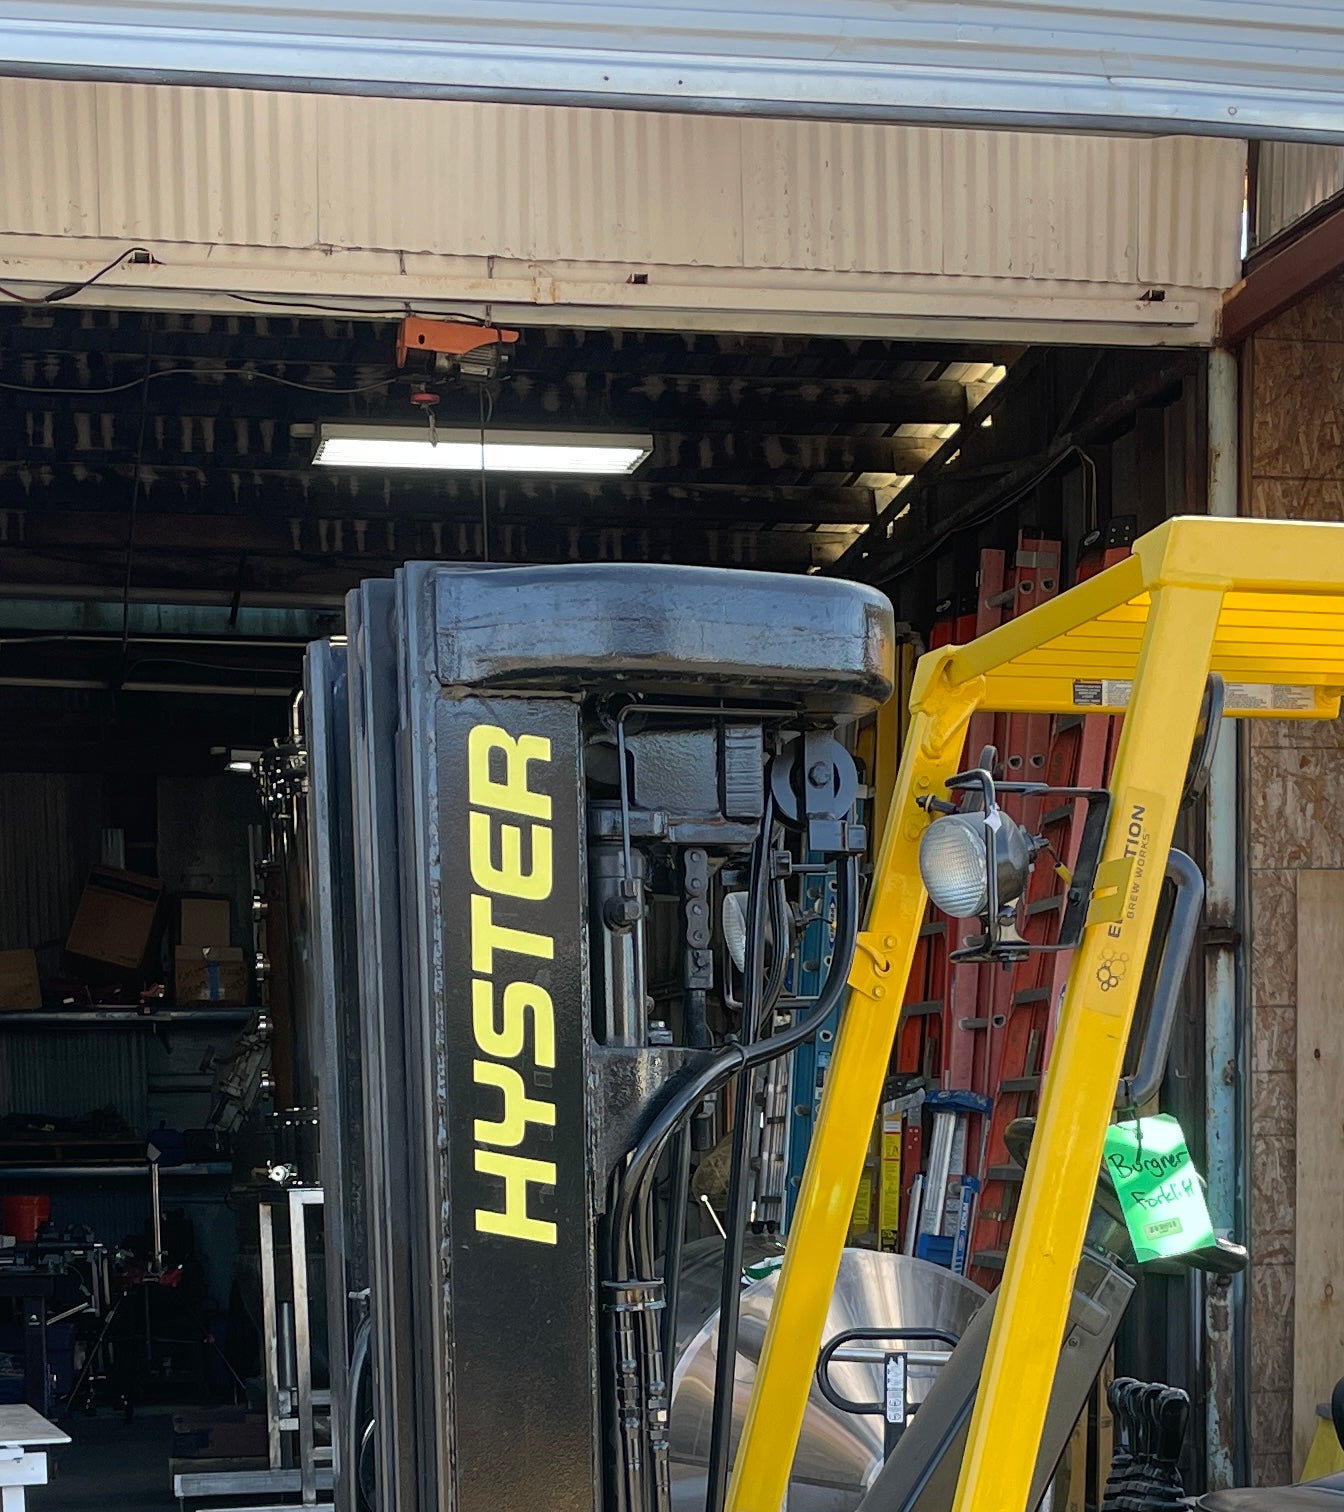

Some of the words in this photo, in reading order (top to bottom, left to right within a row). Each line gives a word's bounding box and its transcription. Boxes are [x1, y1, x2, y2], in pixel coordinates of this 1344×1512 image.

[469, 724, 557, 1244] HYSTER
[1126, 881, 1140, 918] BREW
[1136, 834, 1150, 878] WORKS
